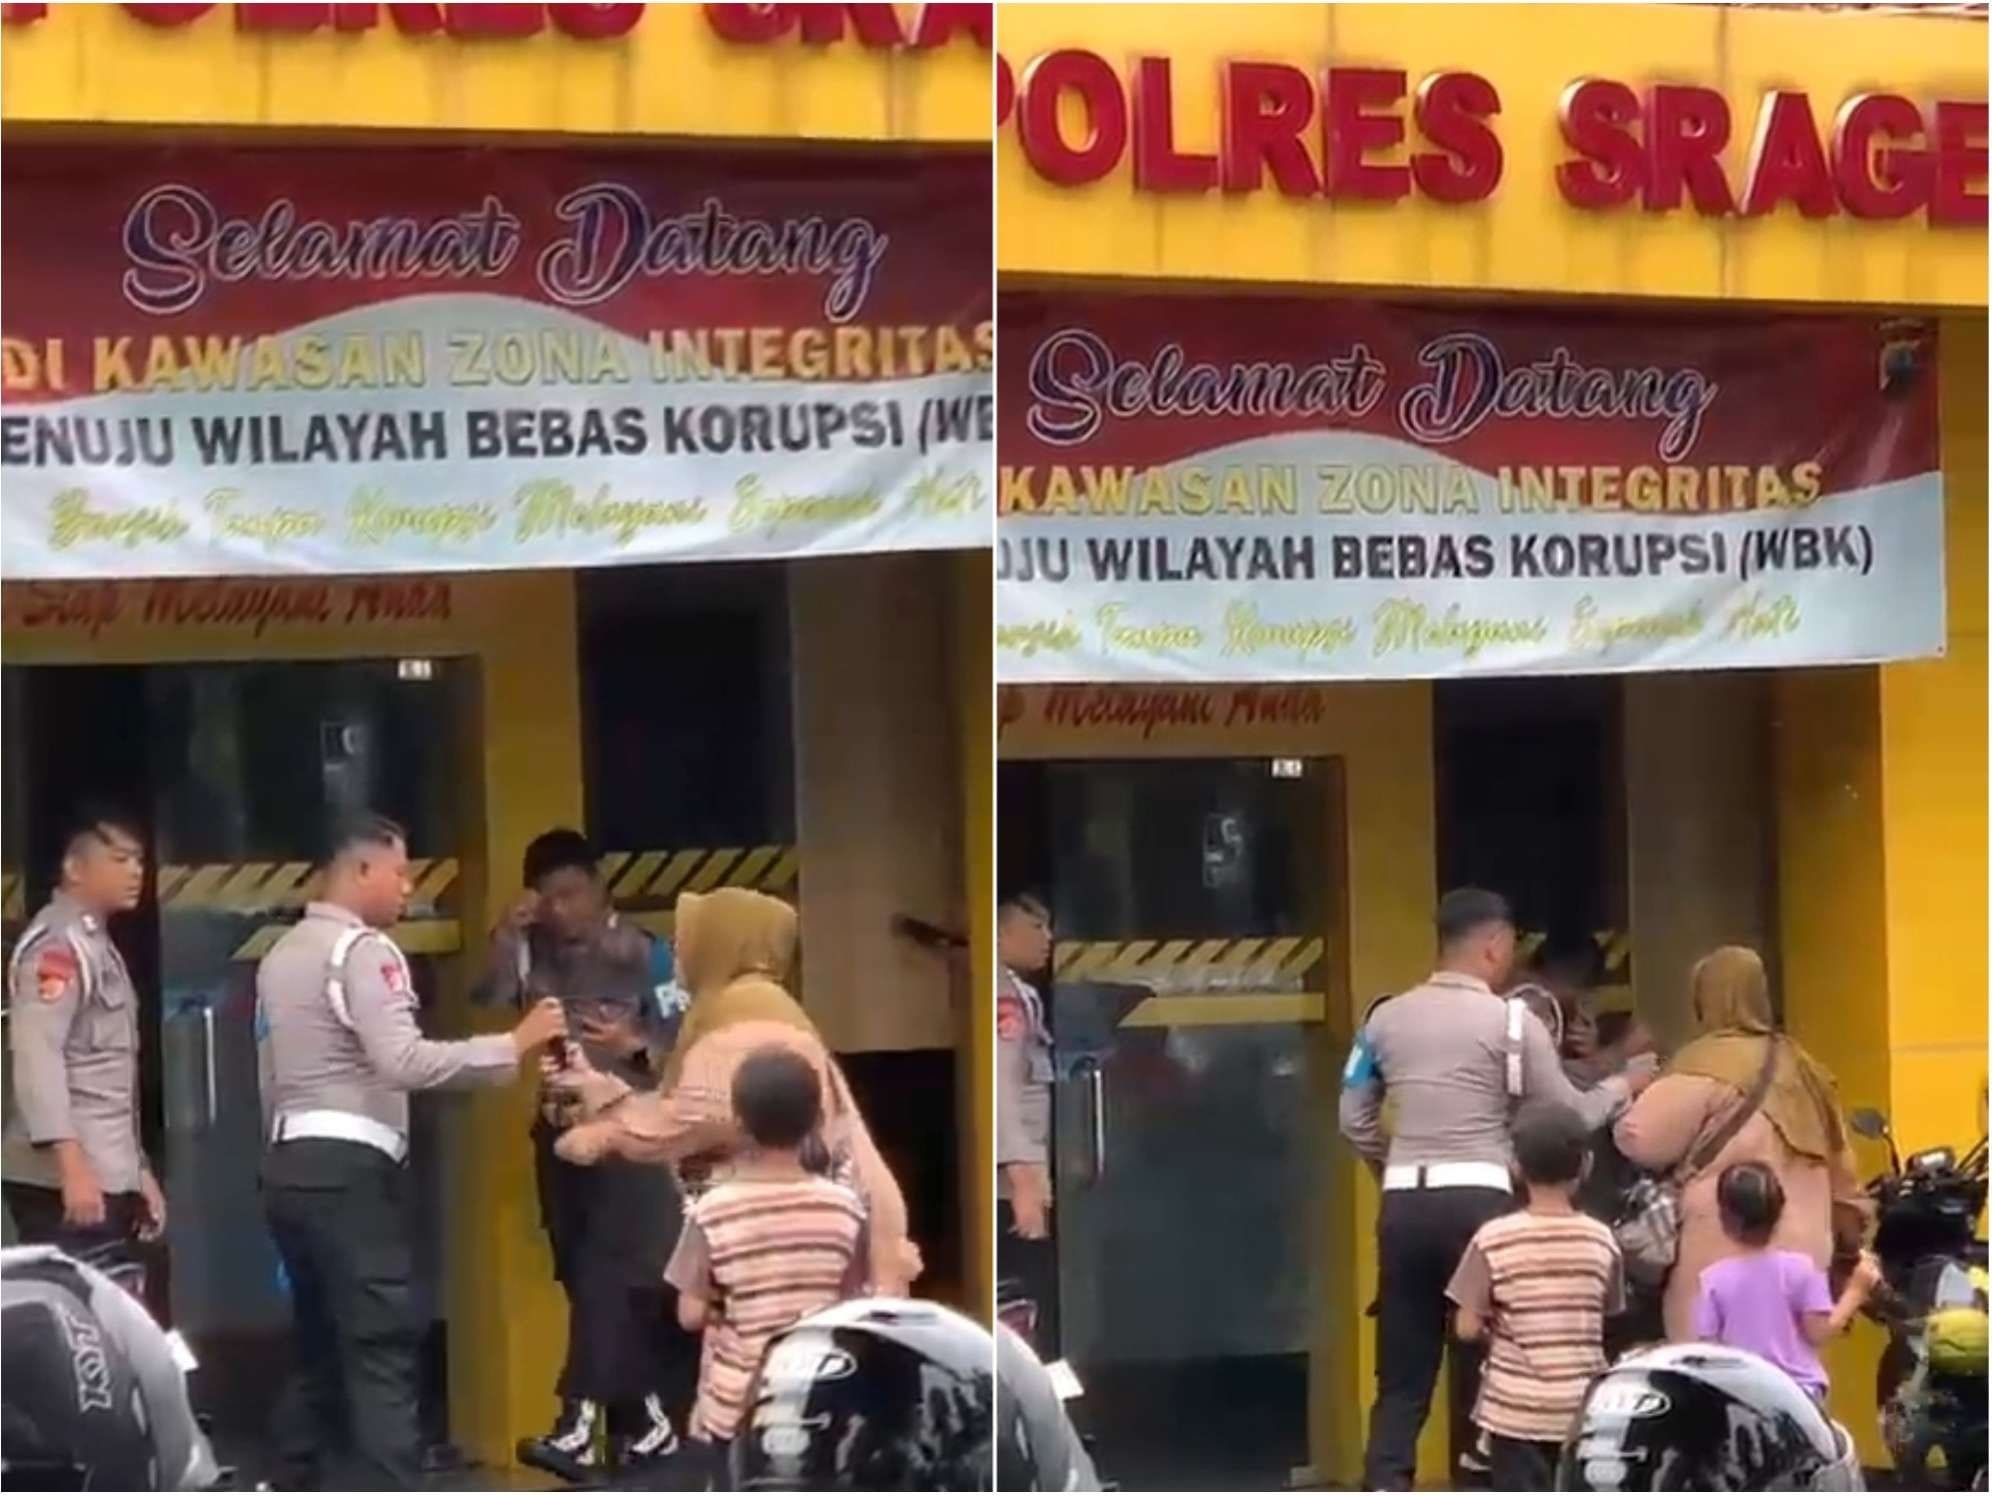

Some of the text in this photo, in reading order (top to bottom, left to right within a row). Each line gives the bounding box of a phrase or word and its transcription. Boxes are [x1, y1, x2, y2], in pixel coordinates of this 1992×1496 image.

[997, 48, 1503, 203] OLRES
[122, 182, 887, 324] Selamat Datang
[2, 321, 992, 393] DI KAWASAN ZONA INTEGRITAS
[1028, 328, 1718, 463] Selamat Datang
[1, 416, 175, 468] ENUJU
[191, 410, 447, 467] WILAYAH
[467, 405, 648, 461] BEBAS
[664, 401, 902, 456] KORUPSI
[997, 460, 1824, 517] KAWASAN ZONA INTEGRITAS
[1086, 535, 1316, 582] WILAYAH
[1333, 533, 1495, 580] BEBAS
[1511, 531, 1726, 579] KORUPSI
[1739, 524, 1875, 582] (WBK)
